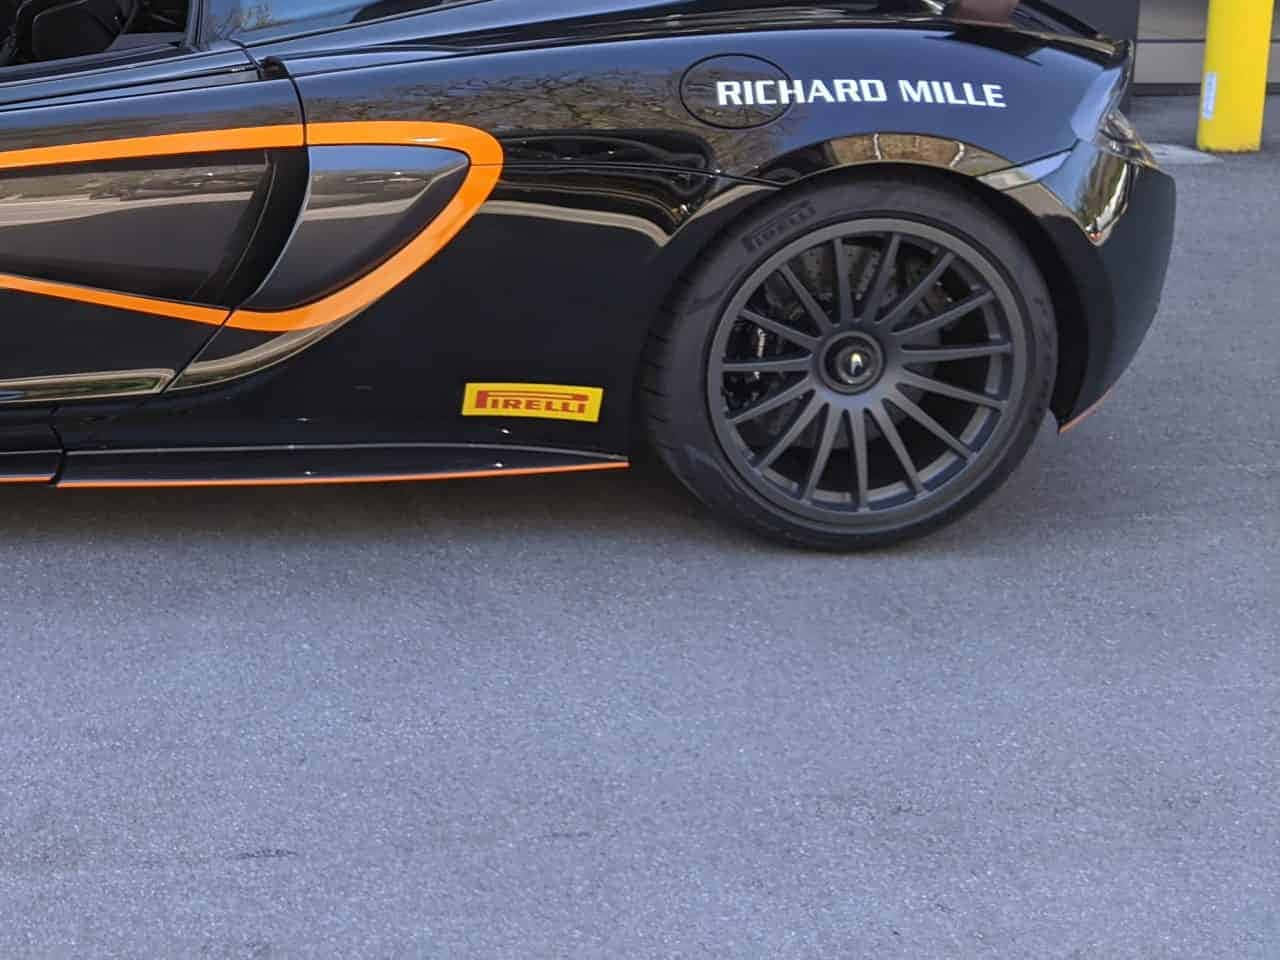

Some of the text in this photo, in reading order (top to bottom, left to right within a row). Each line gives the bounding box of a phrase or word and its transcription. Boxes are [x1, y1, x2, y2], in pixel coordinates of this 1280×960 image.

[716, 79, 1007, 108] RICHARD MILLE
[475, 390, 589, 414] PIRELLI
